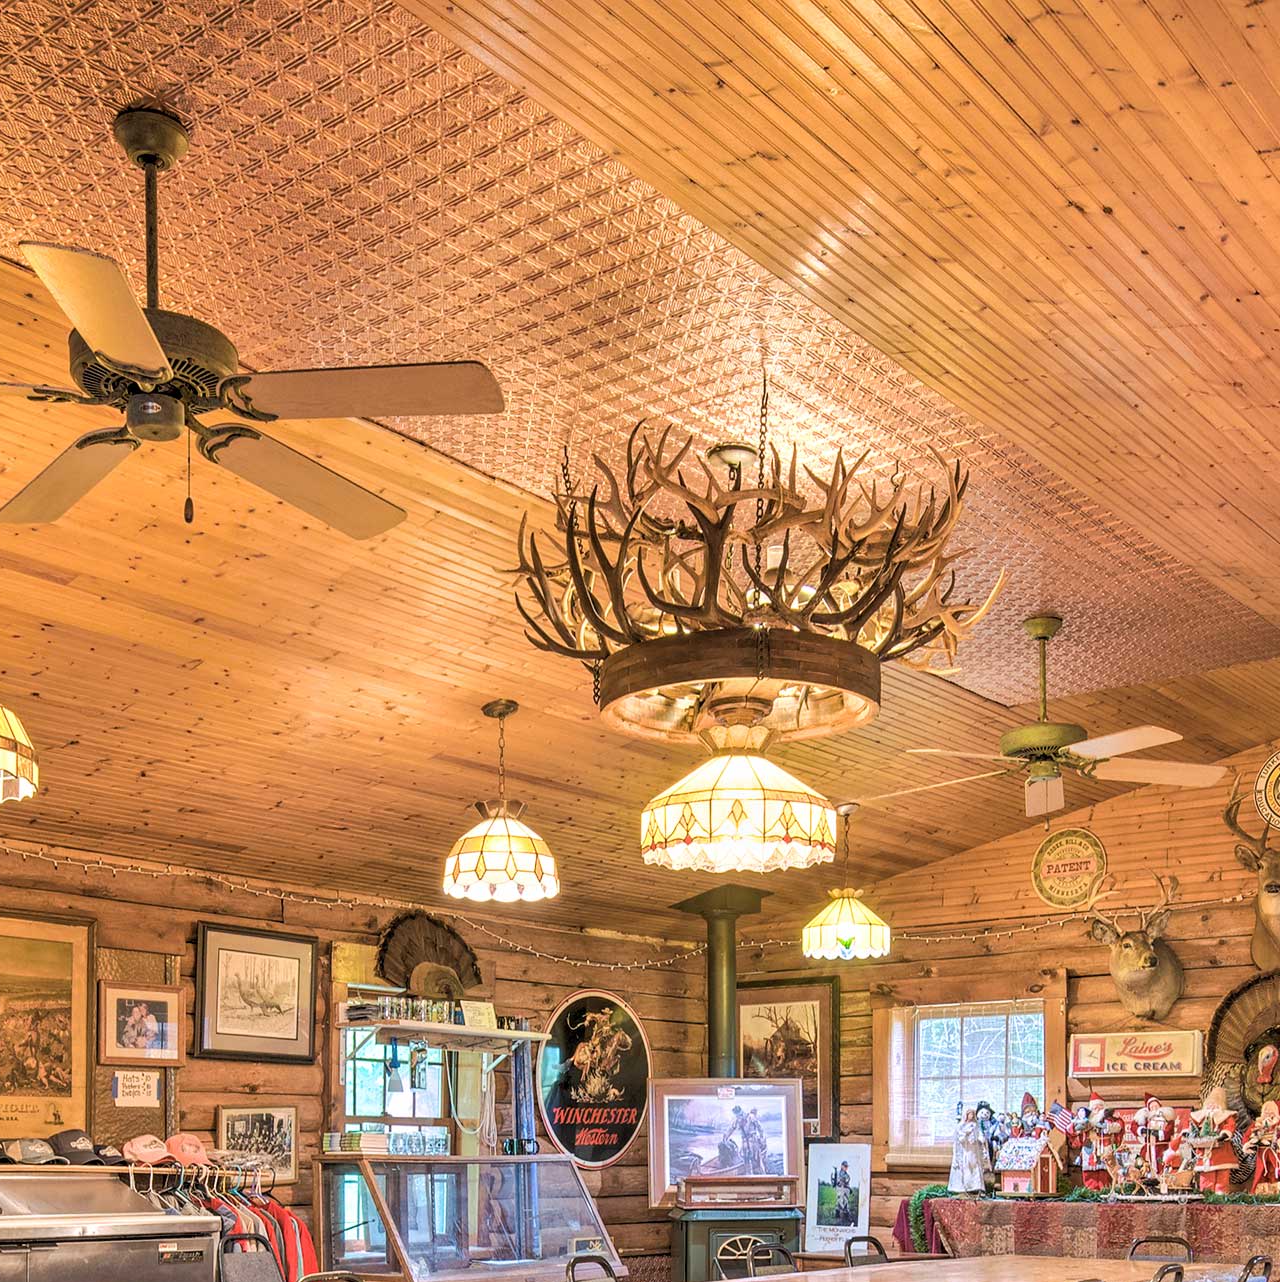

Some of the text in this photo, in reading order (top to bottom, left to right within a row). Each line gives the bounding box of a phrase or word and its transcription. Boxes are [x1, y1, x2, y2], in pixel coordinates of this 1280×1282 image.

[1046, 860, 1091, 874] PATENT
[1048, 882, 1089, 896] MINNESOTA
[1116, 1037, 1174, 1060] Laine's
[1106, 1062, 1182, 1072] ICE CREAM
[553, 1107, 638, 1124] WINCHESTER
[575, 1127, 618, 1146] Western
